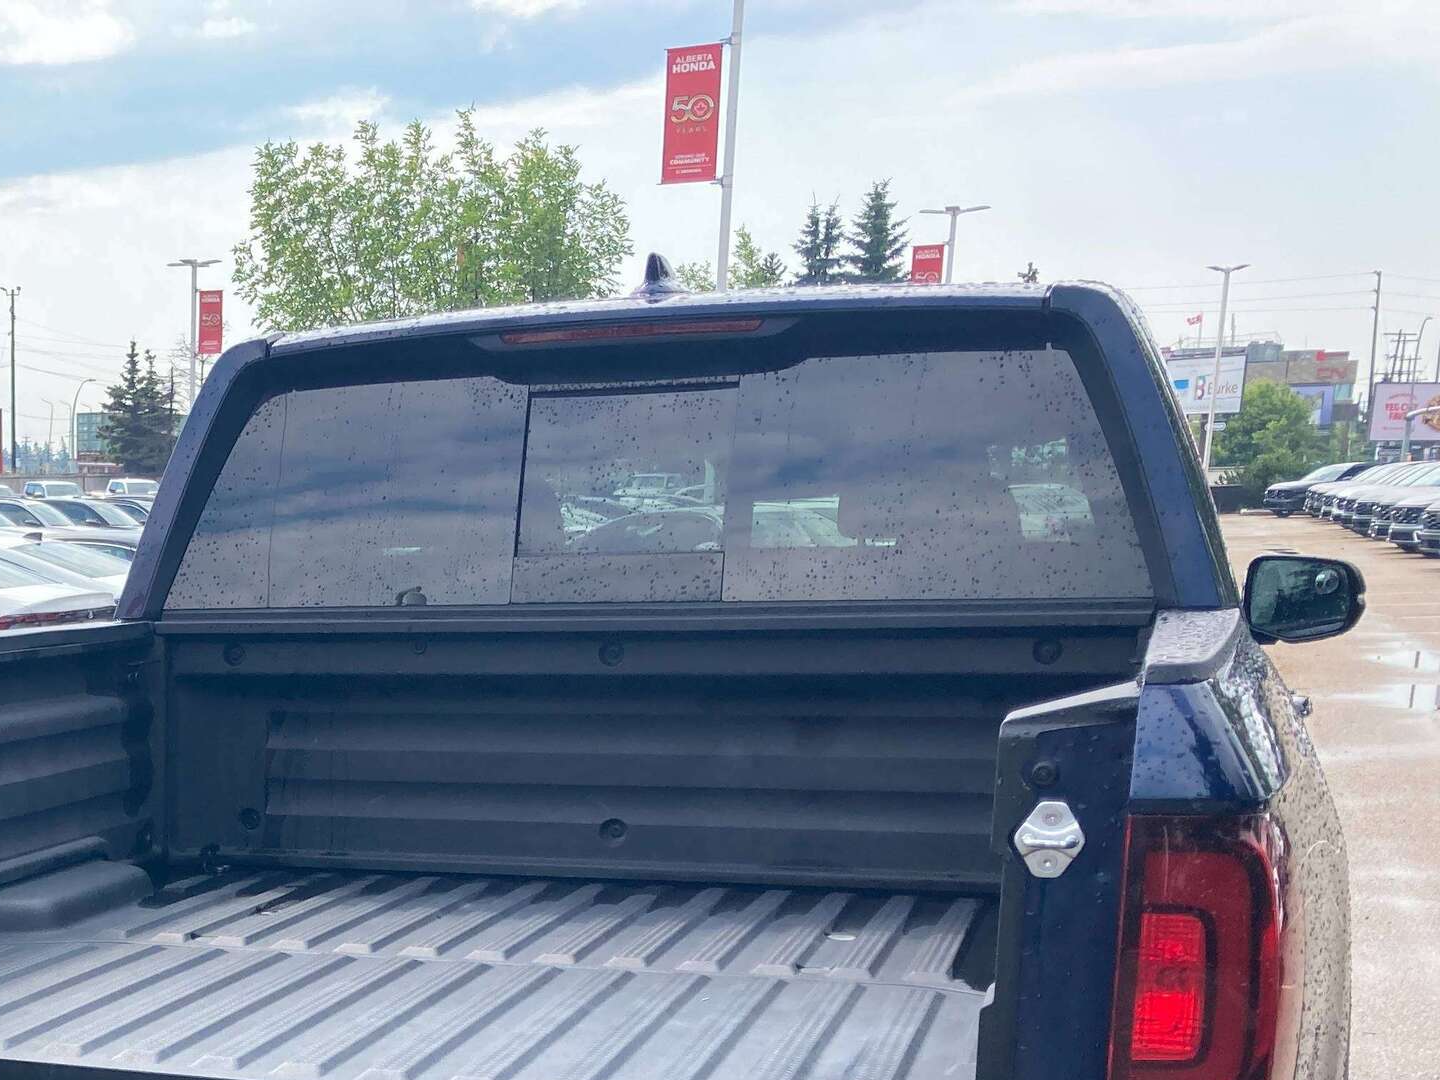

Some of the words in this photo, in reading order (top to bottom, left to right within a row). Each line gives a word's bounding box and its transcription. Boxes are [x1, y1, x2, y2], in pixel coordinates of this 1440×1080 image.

[675, 53, 713, 64] ALBERTA
[672, 60, 716, 74] HONDA
[670, 94, 714, 123] 50
